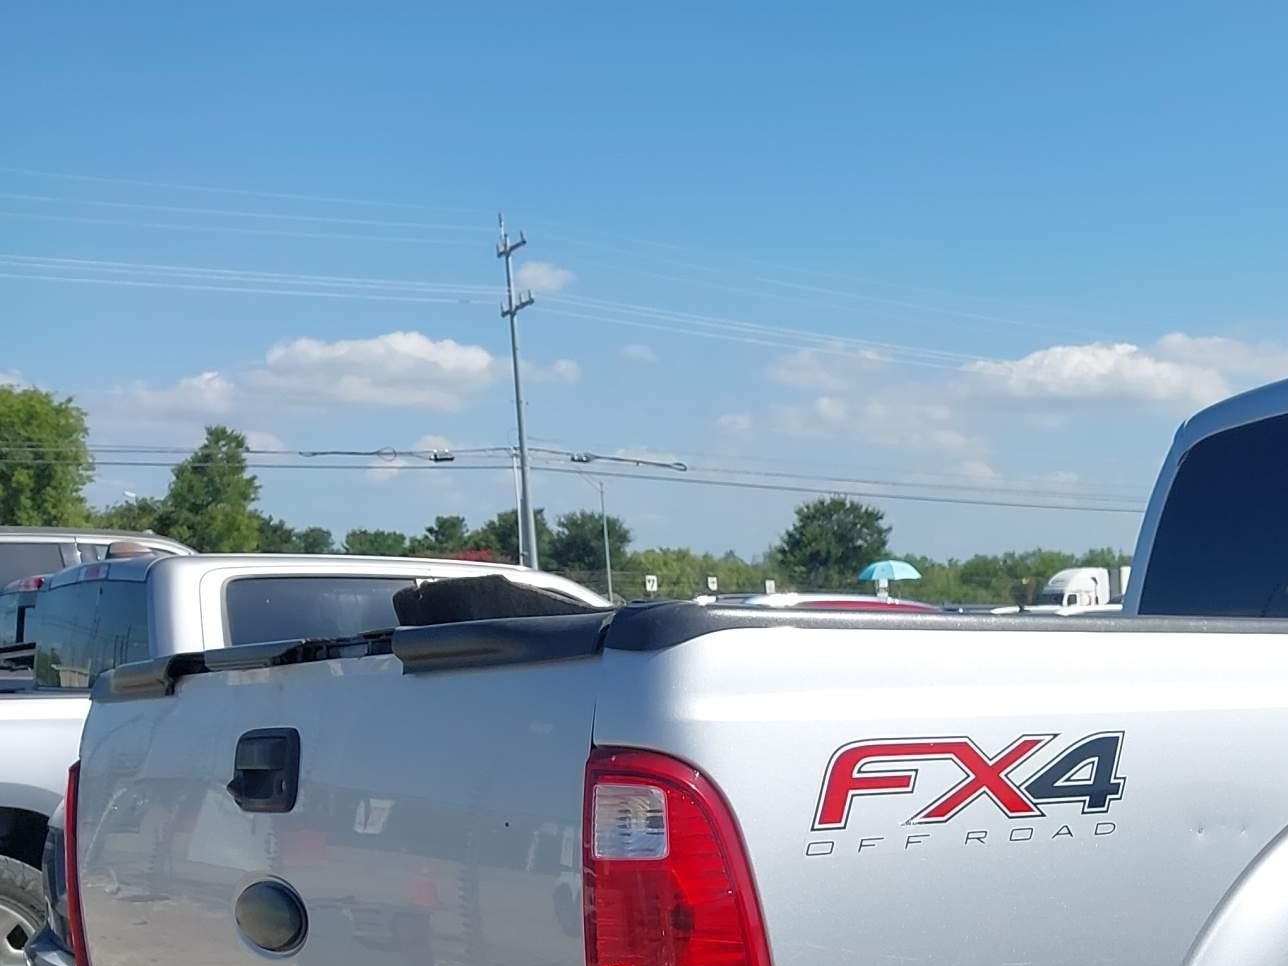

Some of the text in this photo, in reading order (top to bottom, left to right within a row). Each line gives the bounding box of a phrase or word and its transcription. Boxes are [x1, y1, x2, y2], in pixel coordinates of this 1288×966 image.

[810, 731, 1127, 831] FX4
[806, 822, 1117, 856] OFF ROAD
